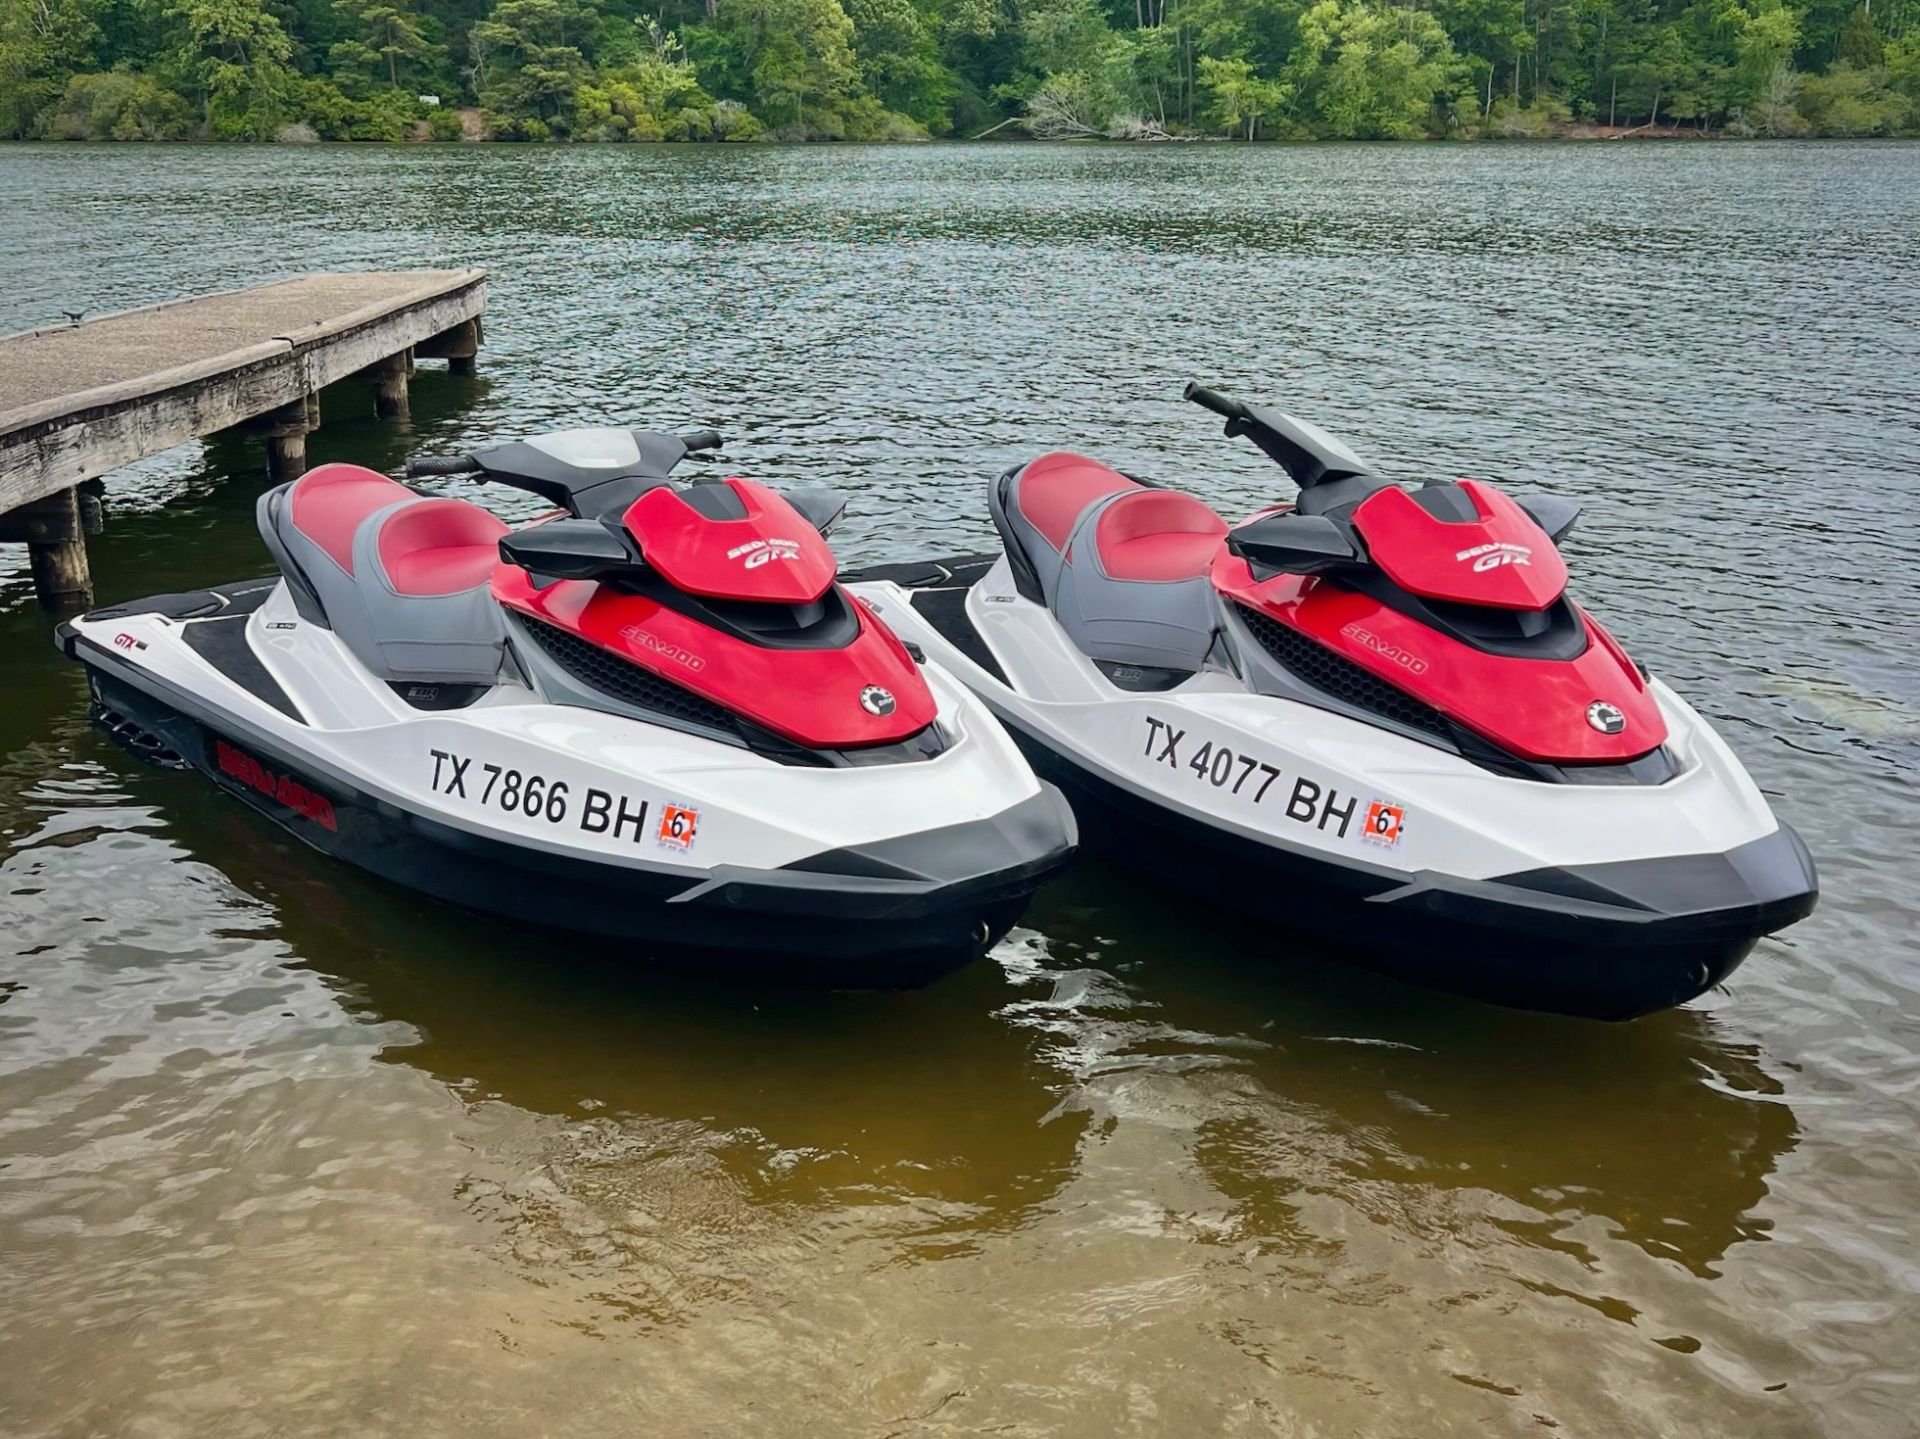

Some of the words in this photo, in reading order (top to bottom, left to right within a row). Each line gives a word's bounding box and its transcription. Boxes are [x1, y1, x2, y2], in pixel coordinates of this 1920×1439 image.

[745, 545, 801, 569] GTX
[1473, 551, 1532, 572] GTX
[114, 633, 137, 652] GTX
[1145, 716, 1186, 769] TX
[1189, 741, 1281, 804] 4077
[1285, 776, 1358, 838] BH
[430, 748, 472, 799] TX
[481, 763, 569, 823] 7866
[580, 787, 649, 843] BH
[671, 812, 685, 838] 6
[1376, 808, 1391, 834] 6
